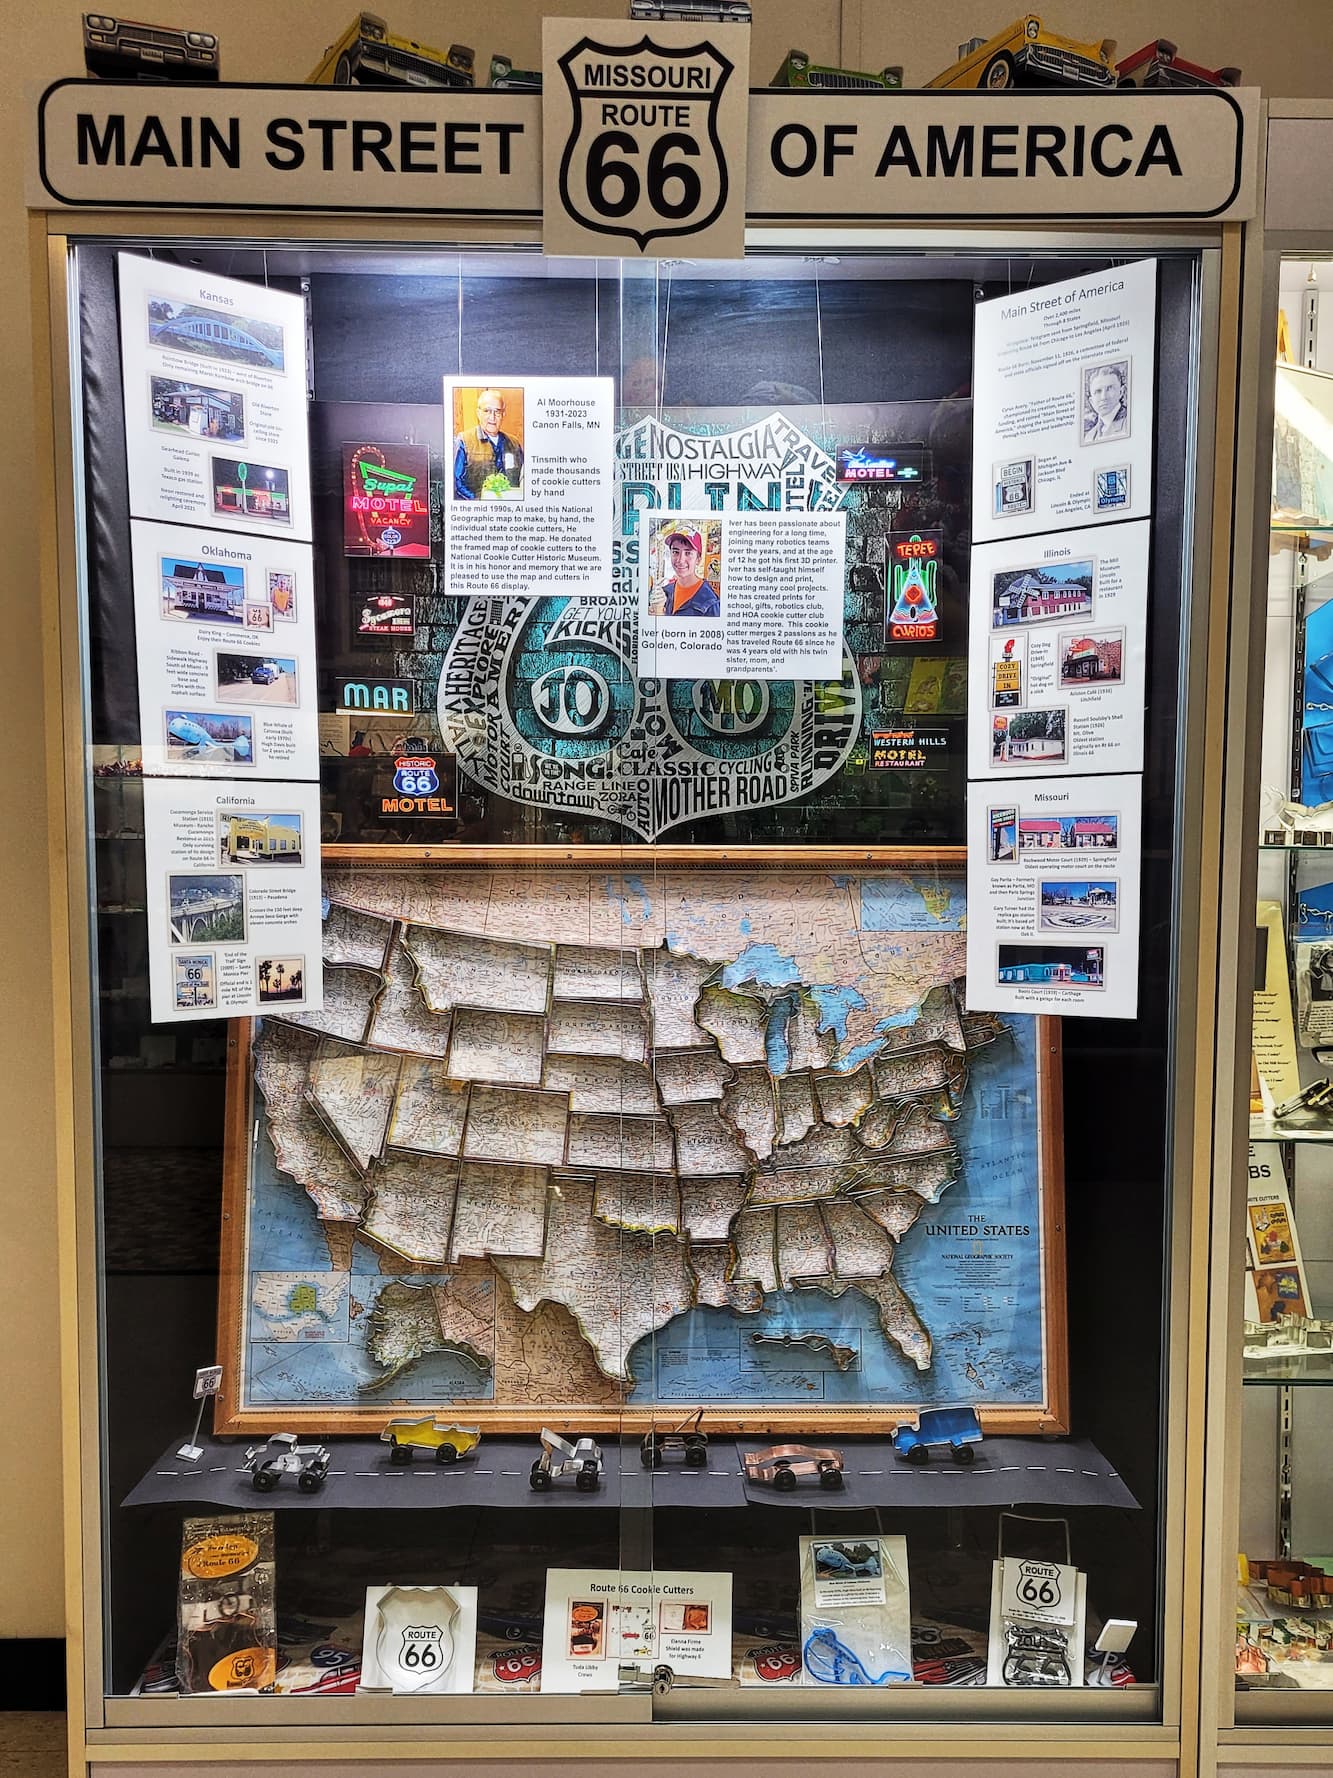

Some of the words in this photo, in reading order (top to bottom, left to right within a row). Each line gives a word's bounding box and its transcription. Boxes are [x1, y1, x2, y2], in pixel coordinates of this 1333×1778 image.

[584, 63, 711, 91] MISSOURI
[602, 103, 691, 128] ROUTE
[77, 114, 241, 170] MAIN
[264, 118, 525, 175] STREET
[770, 123, 858, 179] OF
[876, 123, 1184, 178] AMERICA
[586, 131, 702, 220] 66
[200, 289, 234, 306] Kansas
[1000, 303, 1027, 320] Main
[1030, 295, 1062, 313] Street
[1064, 291, 1077, 304] of
[1078, 280, 1124, 301] America
[562, 422, 584, 430] Falls,
[650, 423, 782, 460] NOSTALGIA
[620, 462, 663, 480] STREET
[666, 462, 686, 480] USA
[688, 463, 783, 480] HIGHWAY
[844, 468, 894, 478] MOTEL
[1004, 466, 1023, 477] BEGIN
[532, 490, 541, 498] by
[352, 496, 428, 512] MOTEL
[451, 515, 494, 523] Geographic
[524, 516, 546, 524] make,
[548, 516, 557, 524] by
[560, 516, 581, 524] hand,
[201, 545, 252, 561] Oklahoma
[897, 542, 935, 556] TEPEE
[1044, 546, 1071, 559] Illinois
[580, 596, 639, 606] BROADW
[562, 607, 594, 620] GET
[598, 607, 632, 620] YOUR
[552, 620, 632, 658] KICKS
[662, 630, 686, 639] (born
[700, 630, 724, 640] 2008)
[892, 624, 935, 638] CURIOS
[444, 600, 488, 696] HERITAGE
[680, 642, 722, 650] Colorado
[462, 625, 499, 730] EXPLORE
[344, 682, 408, 712] MAR
[635, 678, 684, 761] MOTO
[790, 730, 800, 759] PARK
[800, 698, 814, 792] RUNNING
[919, 737, 947, 746] HILLS
[484, 714, 502, 788] MOTOR
[500, 722, 512, 794] COURT
[617, 742, 659, 763] Café
[874, 749, 926, 760] MOTEL
[528, 750, 613, 784] SONG!
[618, 762, 716, 776] CLASSIC
[718, 752, 772, 776] CYCLING
[402, 777, 431, 791] 66
[790, 761, 800, 793] SPIVA
[543, 782, 596, 790] RANGE
[602, 782, 636, 790] LINE
[216, 796, 256, 805] California
[382, 798, 453, 812] MOTEL
[512, 782, 604, 811] downtown
[600, 792, 637, 801] ZORA
[1034, 792, 1069, 802] Missouri
[637, 779, 650, 835] AUTO
[652, 776, 730, 836] MOTHER
[737, 775, 788, 806] ROAD
[188, 968, 201, 979] 66
[925, 1225, 978, 1236] UNITED
[984, 1225, 1030, 1236] STATES
[202, 1559, 226, 1567] Route
[1025, 1566, 1054, 1576] ROUTE
[590, 1583, 615, 1592] Route
[618, 1585, 628, 1593] 66
[632, 1585, 661, 1594] Cookie
[663, 1586, 694, 1594] Cutters
[1022, 1578, 1054, 1604] 66
[313, 1650, 349, 1665] 95
[405, 1643, 436, 1667] 66
[752, 1645, 786, 1656] ROUTE
[506, 1656, 536, 1673] 66
[766, 1653, 795, 1670] 66
